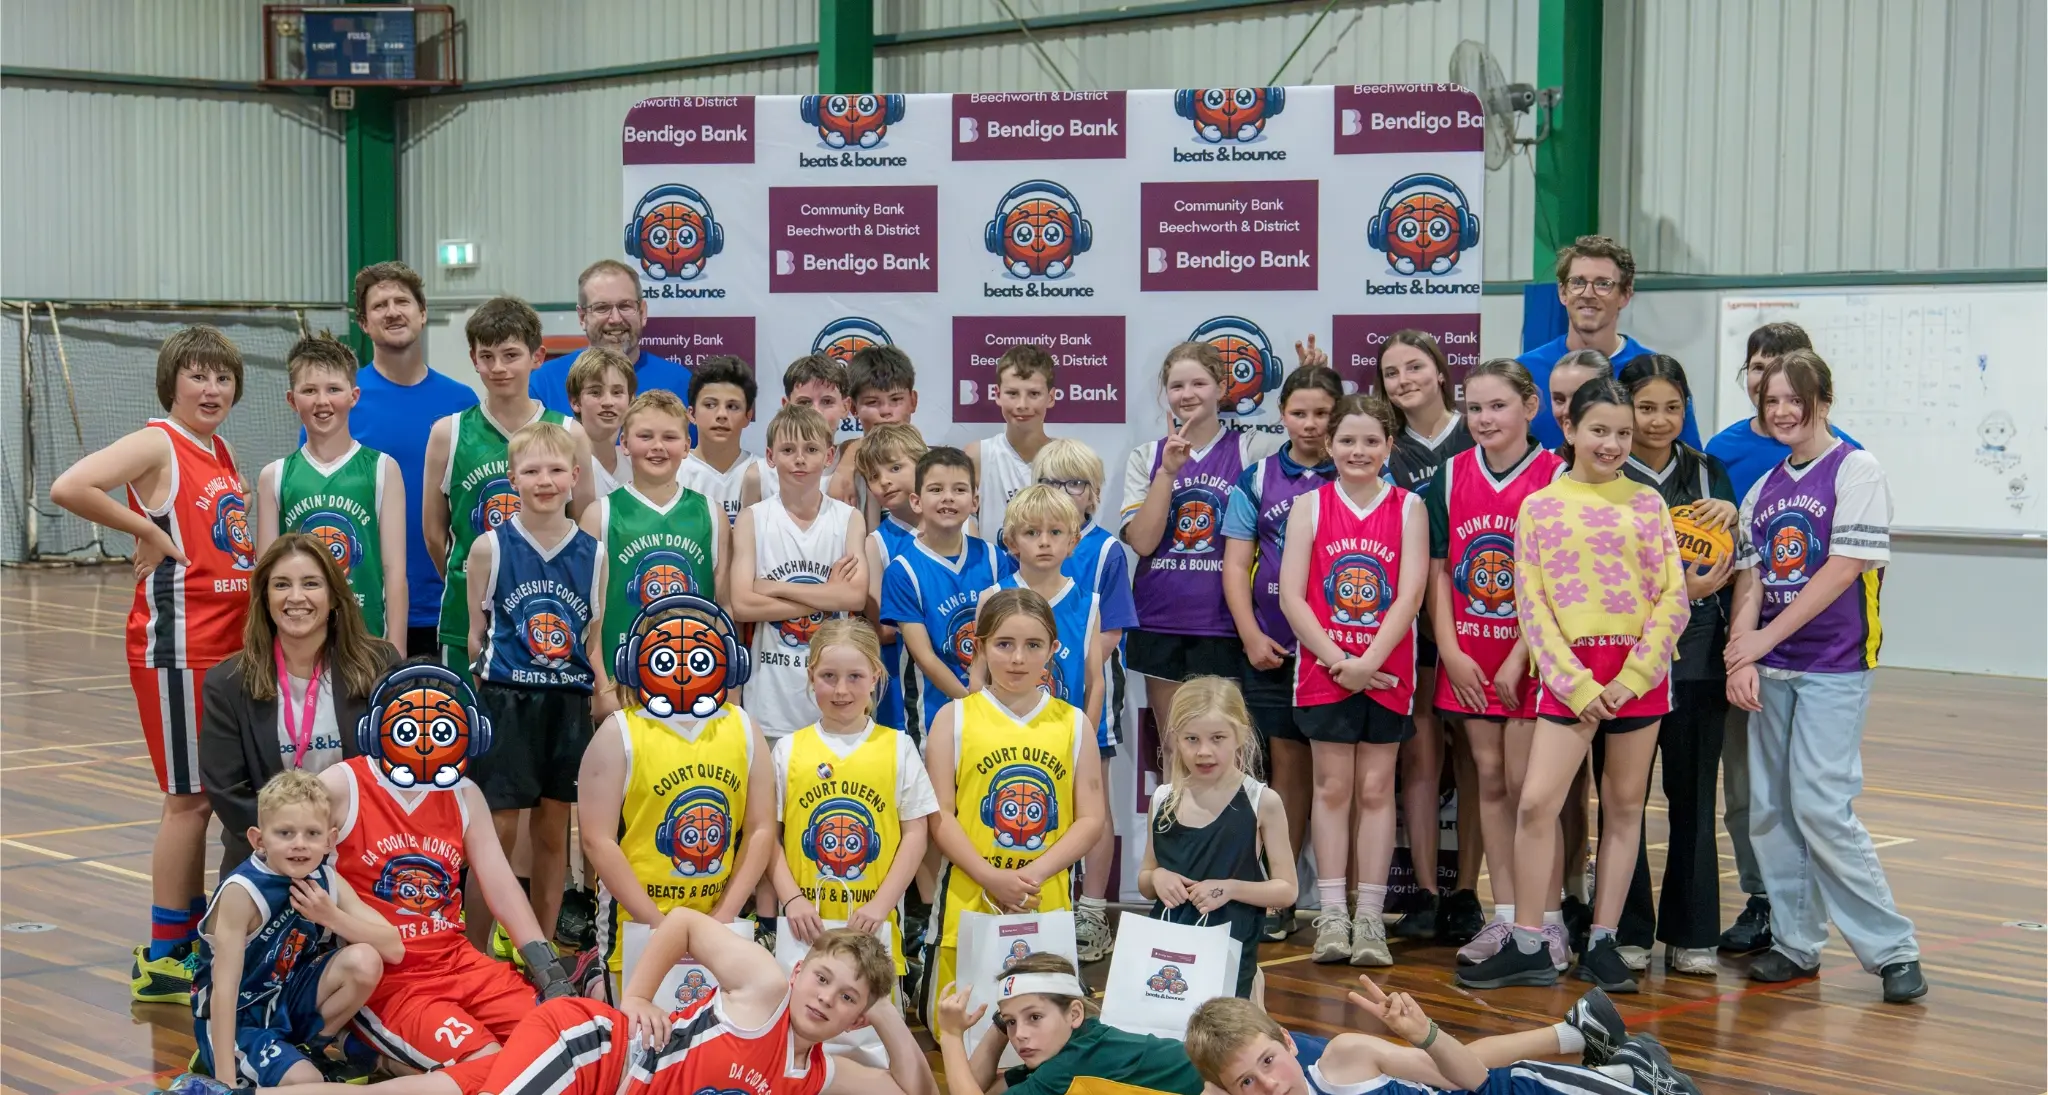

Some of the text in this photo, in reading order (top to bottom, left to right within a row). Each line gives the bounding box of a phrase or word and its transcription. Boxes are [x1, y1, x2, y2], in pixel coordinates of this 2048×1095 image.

[970, 89, 1108, 103] Beechworth & District
[1353, 83, 1433, 95] Beechworth
[1437, 83, 1446, 92] &
[683, 96, 692, 107] &
[695, 96, 738, 107] District
[1371, 111, 1452, 134] Bendigo
[1457, 110, 1485, 128] Ba
[624, 124, 748, 147] Bendigo Bank
[987, 120, 1064, 143] Bendigo
[1070, 118, 1119, 137] Bank
[799, 152, 907, 168] beats & bounce
[1173, 146, 1287, 162] beats & bounce
[800, 203, 905, 218] Community Bank
[1173, 199, 1284, 215] Community Bank
[786, 223, 920, 237] Beechworth & District
[1159, 219, 1300, 234] Beechworth & District
[803, 254, 879, 275] Bendigo
[883, 253, 931, 271] Bank
[1176, 250, 1256, 273] Bendigo
[1260, 248, 1310, 268] Bank
[641, 284, 726, 299] ats & bounce
[983, 282, 1095, 298] beats & bounce
[1366, 279, 1480, 296] beats & bounce
[693, 333, 724, 346] Bank
[985, 333, 1092, 348] Community Bank
[1444, 331, 1477, 344] Bank
[684, 354, 693, 366] &
[1051, 354, 1108, 366] & District
[1447, 353, 1480, 366] Distri
[1069, 383, 1118, 401] Bank
[840, 417, 854, 431] &
[461, 460, 510, 492] DUNKIN'
[1184, 473, 1235, 496] BADDIES
[285, 494, 371, 527] DUNKIN' DONUTS
[1264, 499, 1290, 521] THE
[1753, 494, 1827, 528] THE BADDIES
[1456, 514, 1519, 541] DUNK DIV
[618, 533, 705, 565] DUNKIN' DONUTS
[1325, 537, 1395, 563] DUNK DIVAS
[1151, 557, 1224, 571] BEATS & BOUNC
[213, 578, 248, 593] BEATS
[502, 580, 589, 621] AGGRESSIVE COOKIES
[937, 592, 967, 617] KING
[1345, 631, 1353, 643] &
[1483, 624, 1491, 638] &
[1598, 635, 1607, 647] &
[760, 651, 790, 667] BEATS
[793, 655, 801, 667] &
[512, 669, 547, 684] BEATS
[550, 672, 558, 684] &
[315, 736, 327, 750] &
[977, 746, 1067, 780] COURT QUEENS
[653, 763, 741, 797] COURT QUEENS
[799, 780, 886, 813] COURT QUEENS
[361, 849, 379, 867] DA
[647, 883, 685, 900] BEATS
[689, 885, 697, 898] &
[829, 887, 837, 901] &
[420, 921, 429, 935] &
[434, 1016, 474, 1048] 23
[728, 1062, 744, 1080] DA
